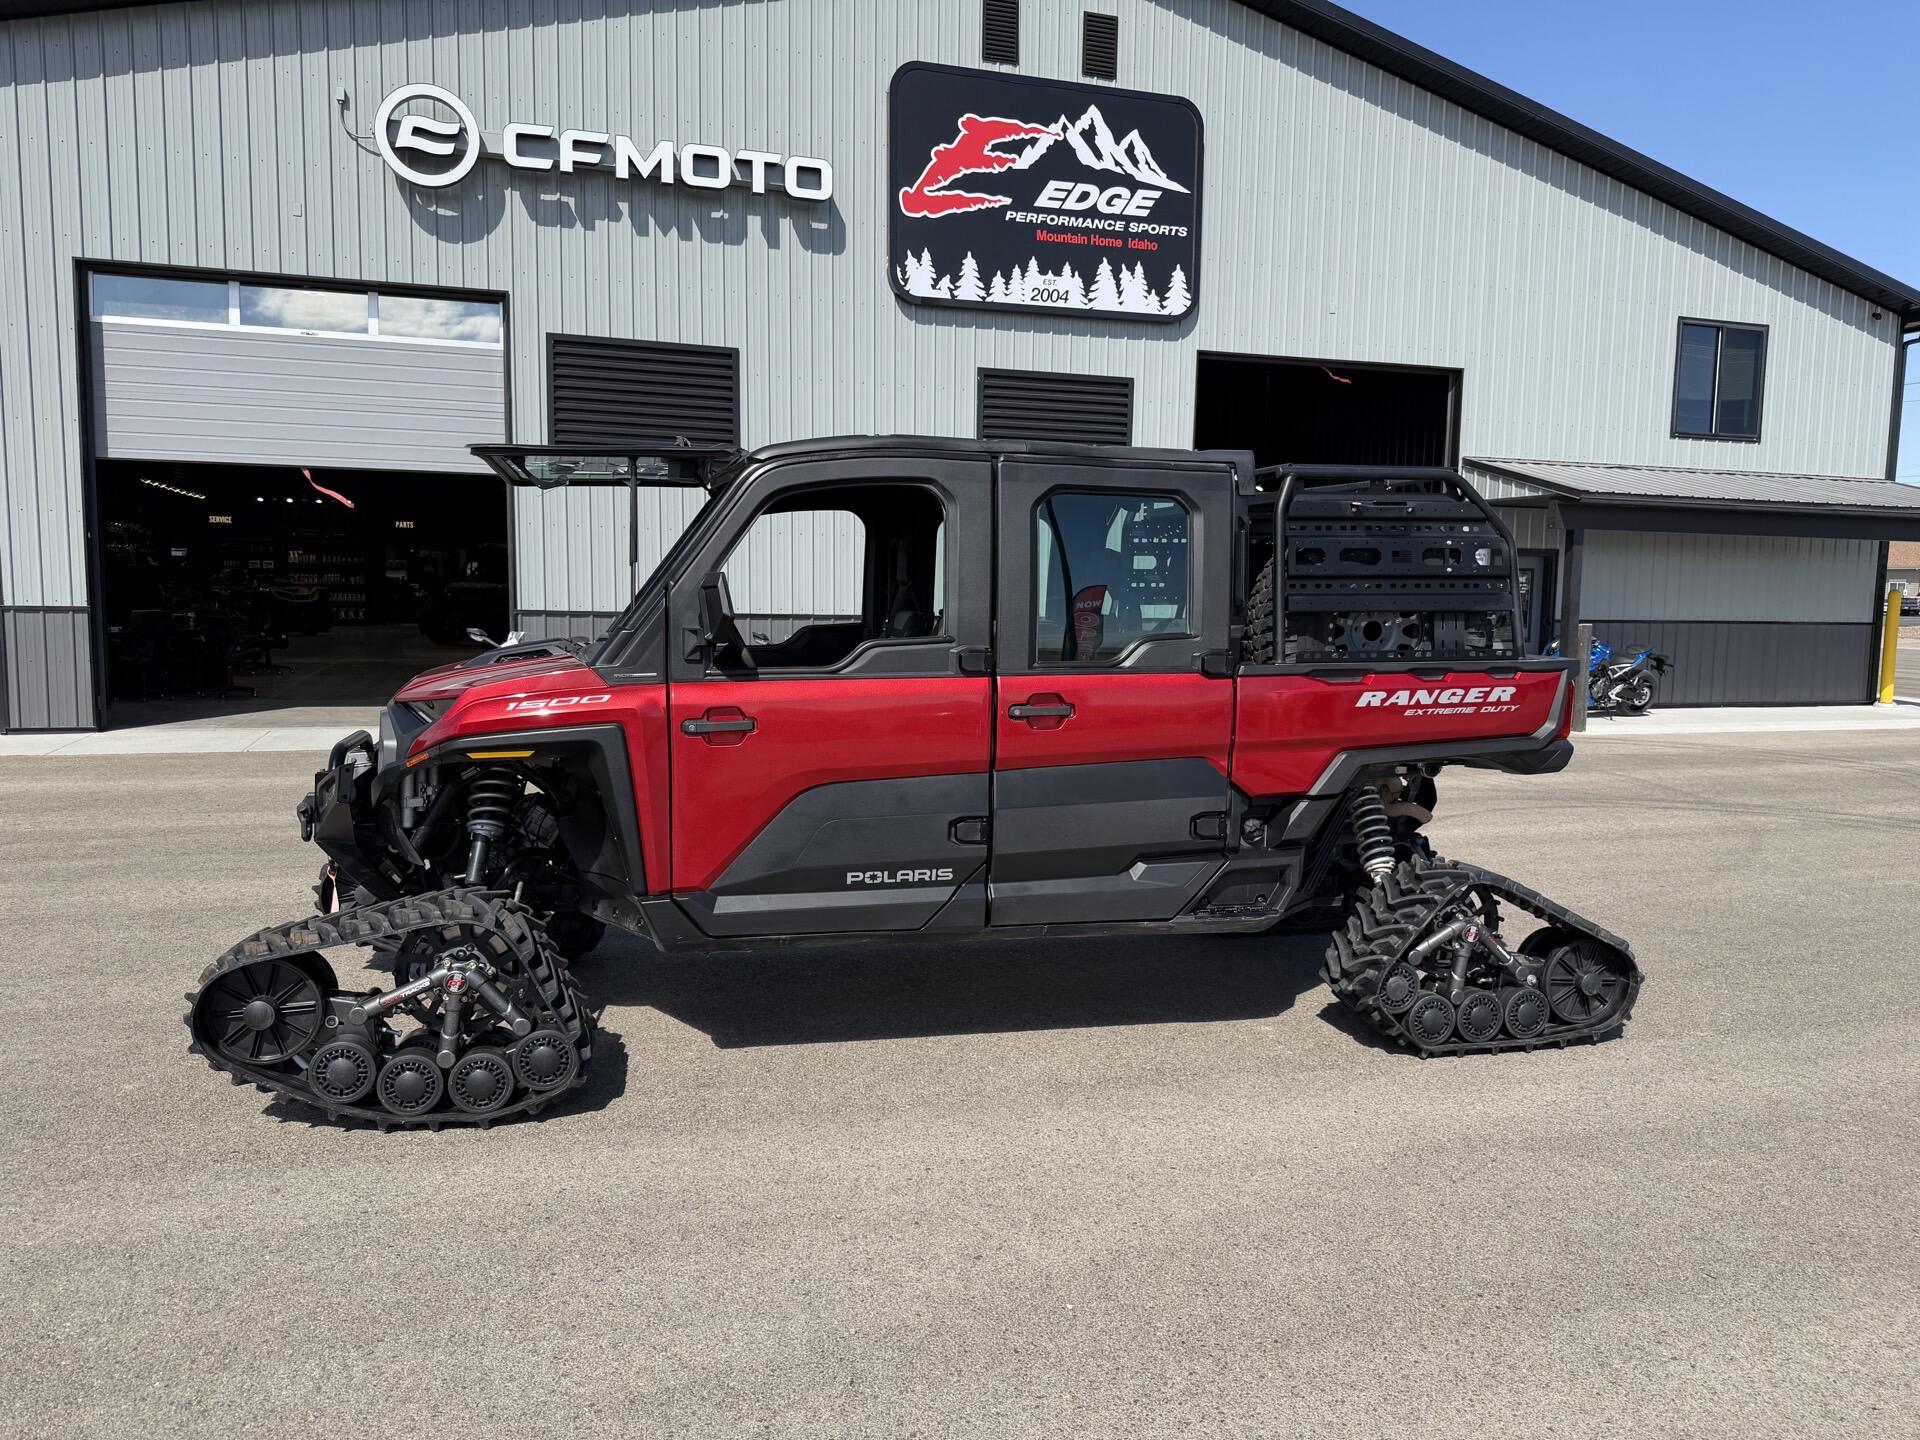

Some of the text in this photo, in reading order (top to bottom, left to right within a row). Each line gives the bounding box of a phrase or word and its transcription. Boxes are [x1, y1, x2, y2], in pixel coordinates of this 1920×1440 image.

[503, 122, 834, 201] CFMOTO
[1033, 180, 1163, 217] EDGE
[1005, 211, 1188, 237] PERFORMANCE SPORTS
[1036, 229, 1159, 251] Mountain Home Idaho
[1030, 287, 1070, 304] 2004
[208, 515, 233, 524] SERVICE
[395, 521, 414, 529] PARTS
[1076, 600, 1102, 609] NOW
[506, 694, 612, 711] 1500
[1355, 687, 1517, 707] RANGER
[1404, 704, 1520, 716] EXTREME DUTY
[846, 868, 954, 885] POLARIS
